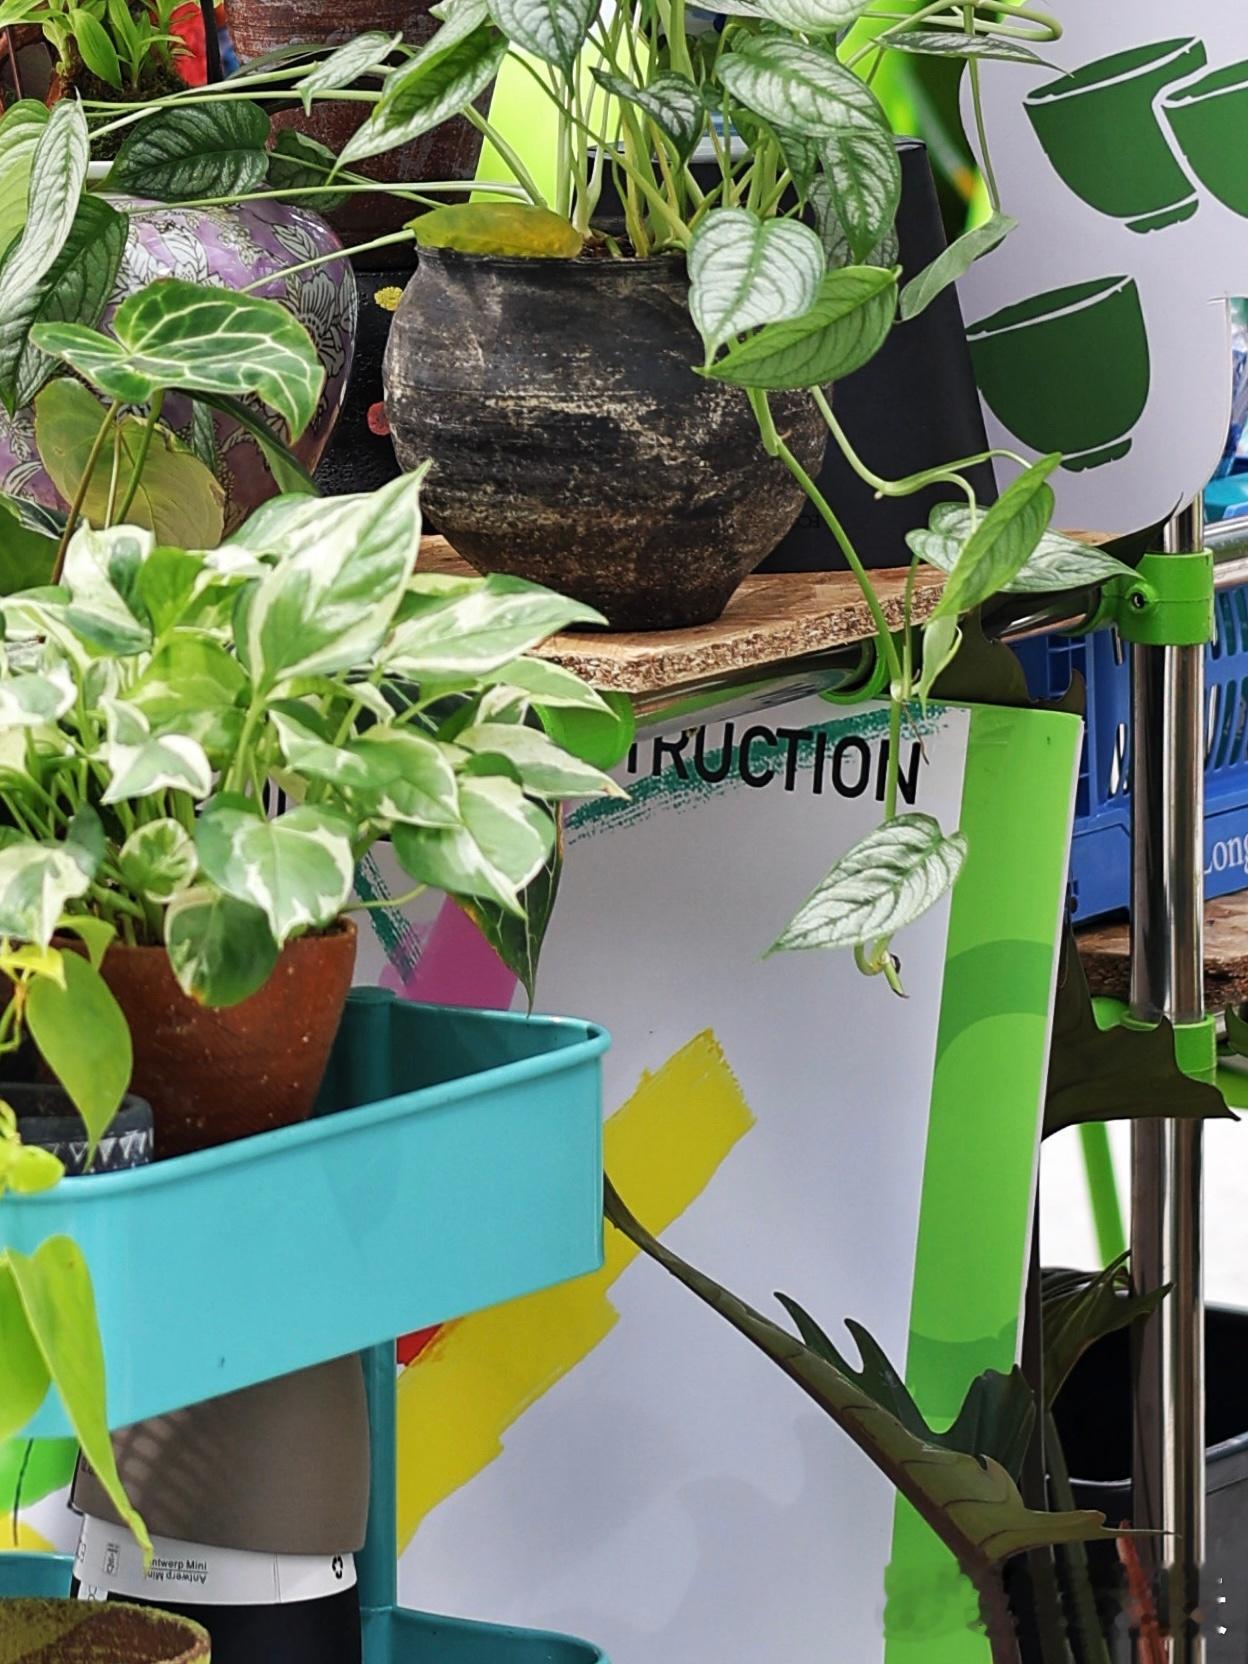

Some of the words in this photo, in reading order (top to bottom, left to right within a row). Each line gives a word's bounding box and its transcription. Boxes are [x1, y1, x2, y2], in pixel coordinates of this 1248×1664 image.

[151, 1558, 184, 1571] ntwerp
[186, 1561, 208, 1571] Mini
[165, 1572, 208, 1584] Antwerp
